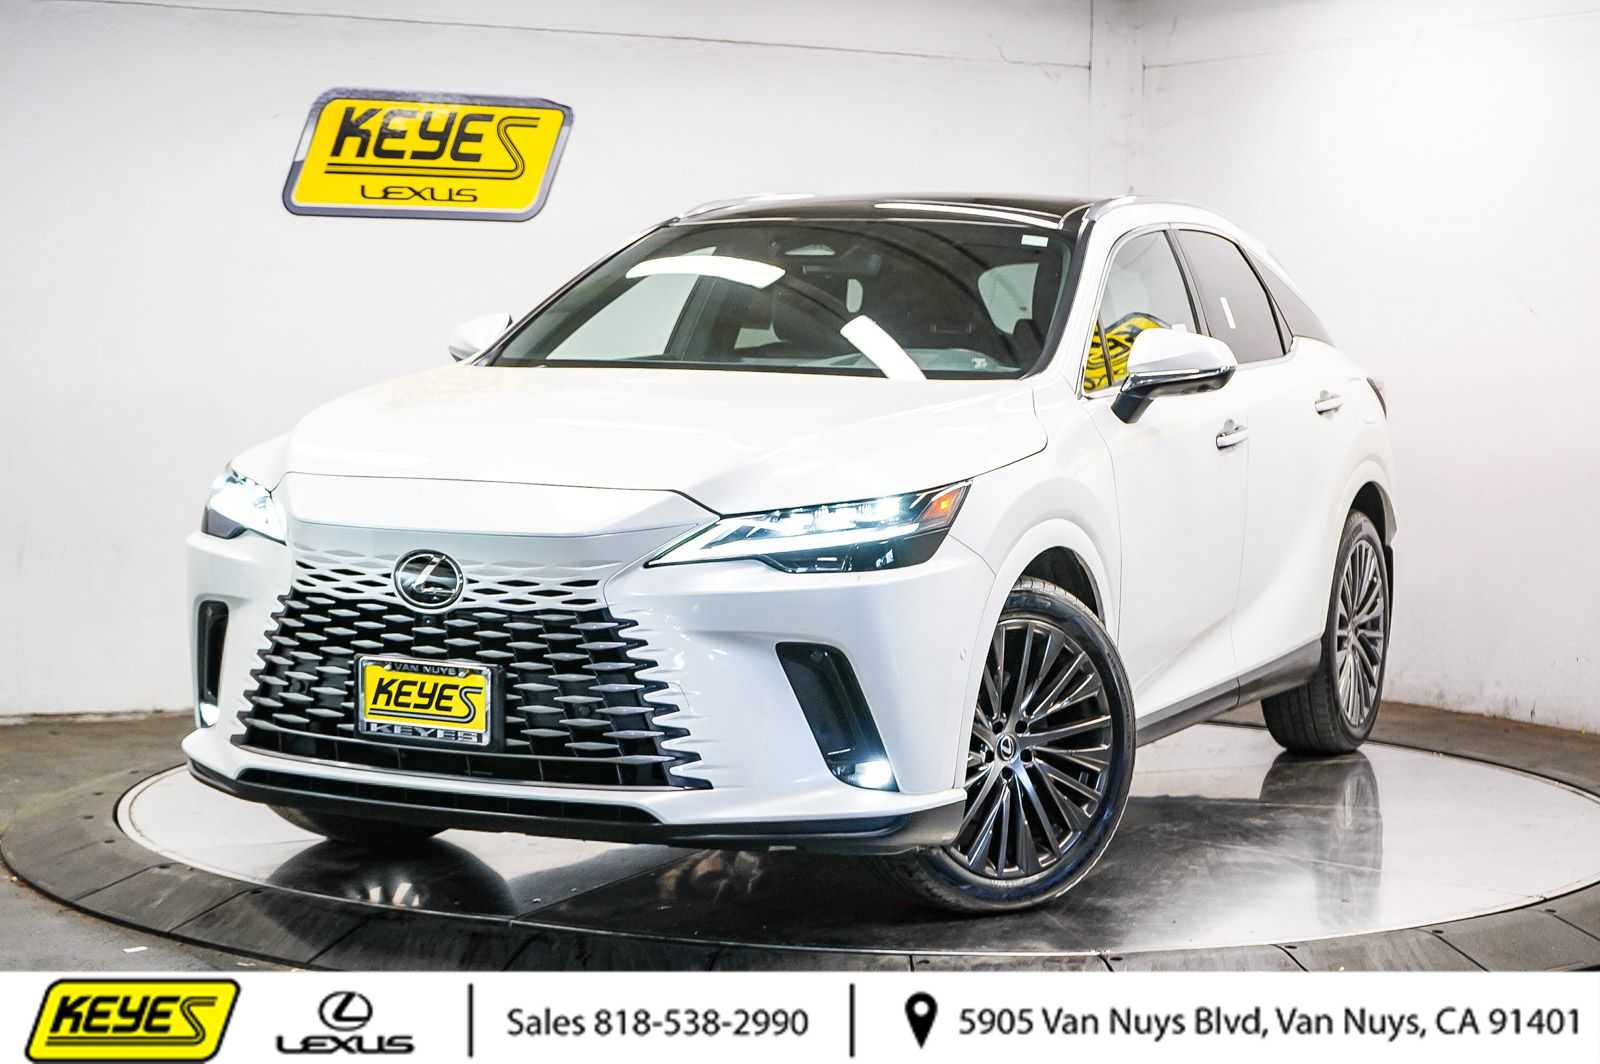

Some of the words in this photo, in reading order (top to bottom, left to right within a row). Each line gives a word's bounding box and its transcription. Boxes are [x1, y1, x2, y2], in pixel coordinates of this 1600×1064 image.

[325, 106, 541, 180] KEYES
[360, 184, 478, 202] LEXUS
[394, 662, 419, 673] VAN
[368, 677, 483, 724] KEYES
[370, 722, 478, 743] KEYES
